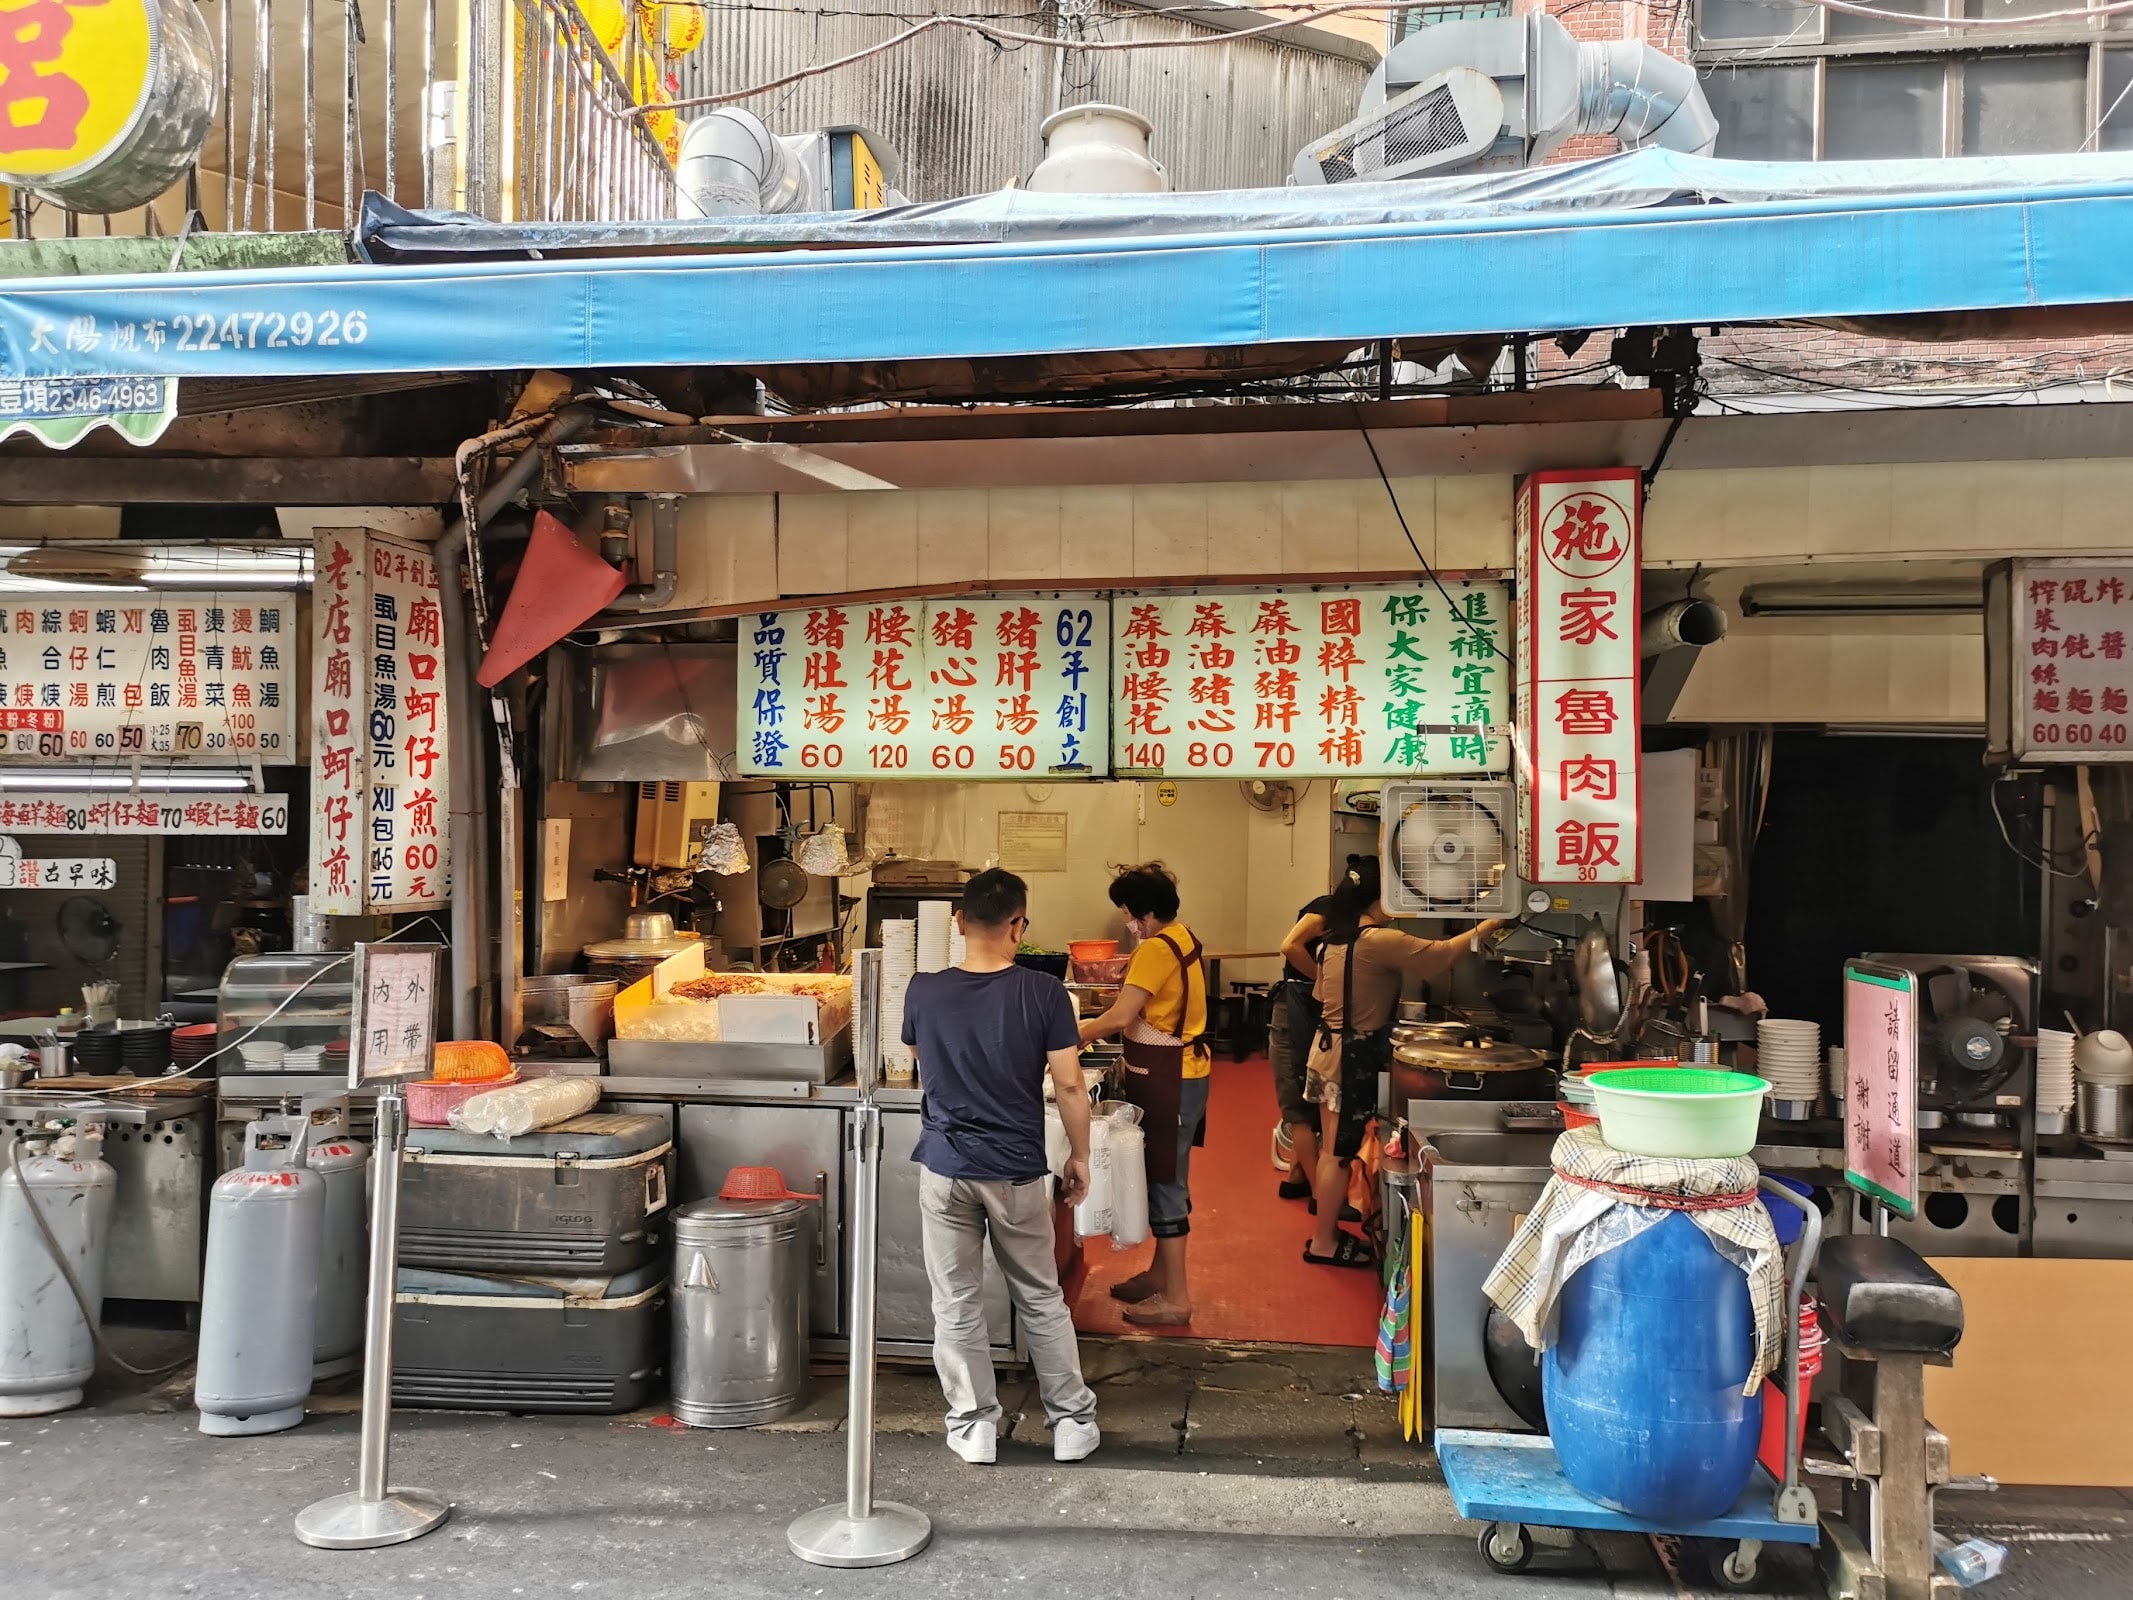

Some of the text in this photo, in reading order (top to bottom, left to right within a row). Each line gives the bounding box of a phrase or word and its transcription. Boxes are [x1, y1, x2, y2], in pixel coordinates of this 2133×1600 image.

[49, 383, 158, 412] 2346-4963
[173, 310, 367, 351] 22472926
[1551, 499, 1622, 646] 施家
[69, 609, 89, 749] 蚵仔湯 60
[95, 609, 116, 748] 蝦仁煎 60
[150, 608, 170, 707] 魯肉飯
[177, 608, 201, 749] 虱目魚湯 70
[204, 608, 226, 748] 燙青菜 30
[231, 608, 253, 708] 燙魷魚
[259, 607, 280, 748] 鯛魚湯 50
[322, 541, 354, 897] 老店廟口蚵仔煎
[752, 612, 790, 769] 品質保證
[800, 607, 850, 769] 豬肚湯 60
[864, 605, 916, 769] 腰花湯 120
[930, 606, 979, 770] 豬心湯 60
[994, 606, 1043, 736] 豬肝湯
[1056, 608, 1093, 770] 62年創立
[1317, 598, 1367, 768] 國粹精補
[1381, 592, 1431, 767] 保大家健康
[1448, 592, 1499, 768] 進補宜適時
[2061, 579, 2096, 743] 餛飩麵 60
[2096, 577, 2129, 743] 炸醬麵 40
[17, 733, 34, 751] 60
[40, 733, 63, 757] 60
[121, 728, 143, 749] 50
[998, 745, 1036, 771] 50
[1123, 742, 1166, 769] 140
[1187, 741, 1234, 768] 80
[1253, 741, 1296, 768] 70
[1555, 688, 1620, 881] 魯肉飯 30
[2033, 723, 2060, 743] 60
[0, 800, 287, 831] 海鮮麵 80 蚵仔麵 70 蝦仁麵 60
[403, 973, 425, 1057] 外帶
[1853, 1073, 1871, 1152] 謝謝
[555, 1215, 593, 1224] IGLOO
